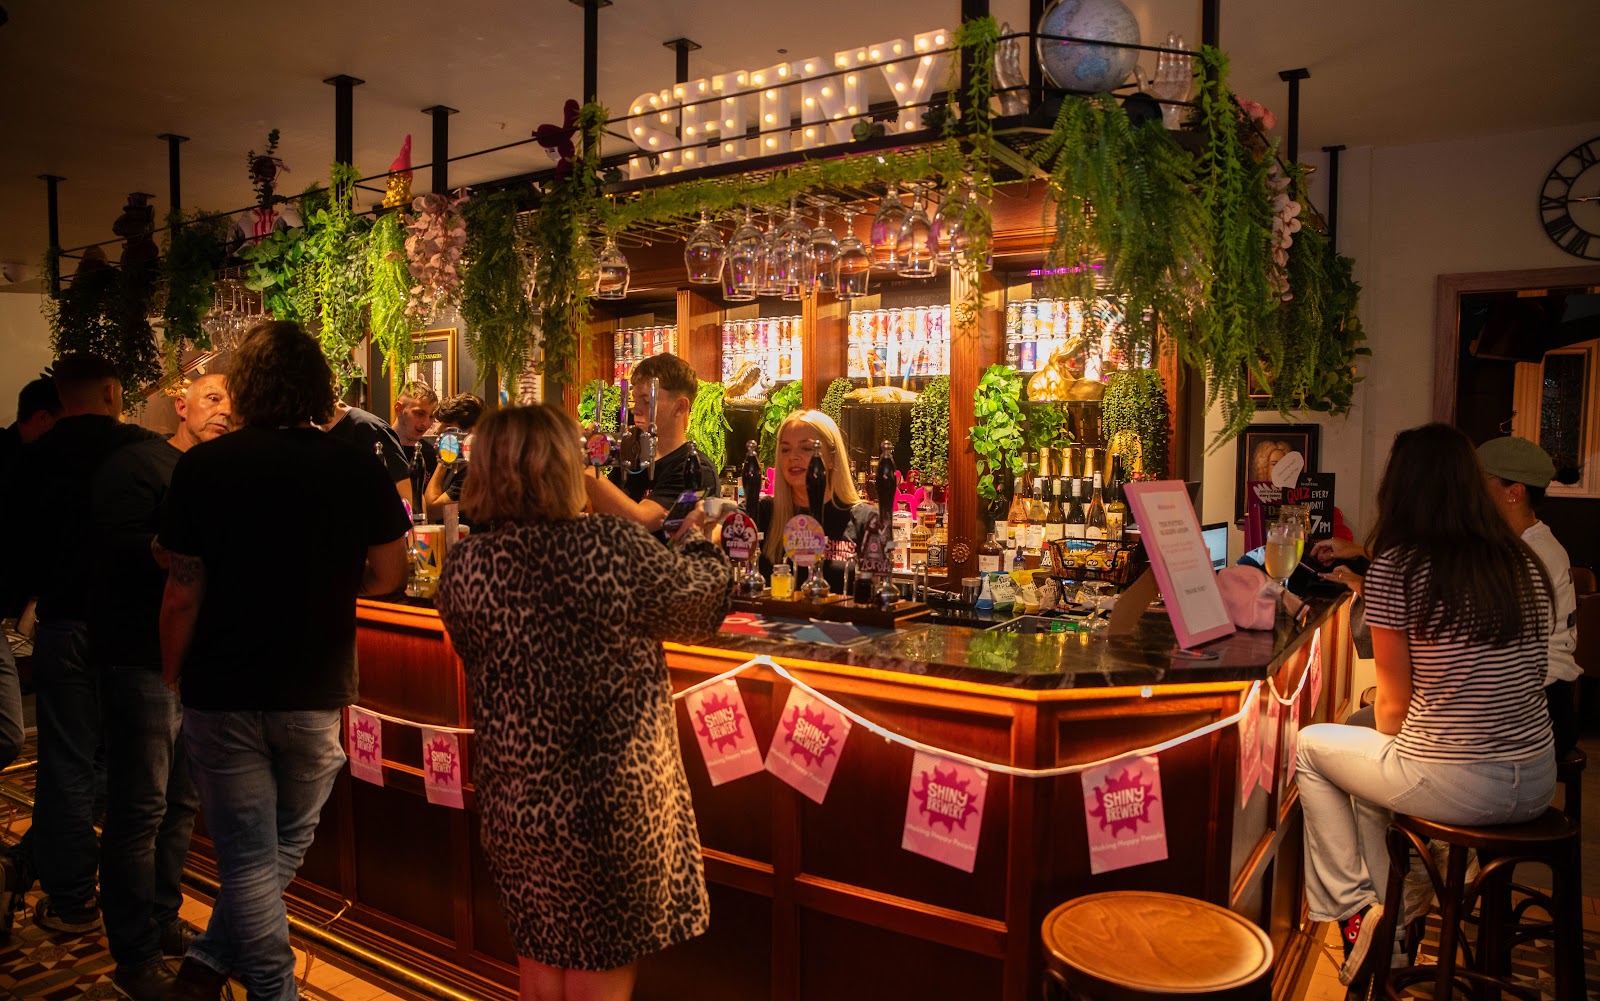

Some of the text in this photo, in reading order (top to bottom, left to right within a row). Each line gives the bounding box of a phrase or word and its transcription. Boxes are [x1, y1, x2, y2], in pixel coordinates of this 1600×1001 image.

[627, 28, 949, 182] SHINY
[1287, 487, 1329, 504] QUIZ EVERY
[725, 540, 753, 550] AFFINITY
[792, 530, 815, 541] SOUL
[823, 551, 857, 563] BREWE
[704, 706, 735, 728] SHINY
[356, 729, 375, 745] SHINY
[791, 728, 826, 757] BREWERY
[795, 717, 830, 747] SHINY
[431, 750, 452, 764] SHINY
[927, 781, 969, 808] SHINY
[1103, 785, 1145, 809] SHINY
[926, 796, 966, 820] BREWERY
[1105, 801, 1145, 823] BREWERY
